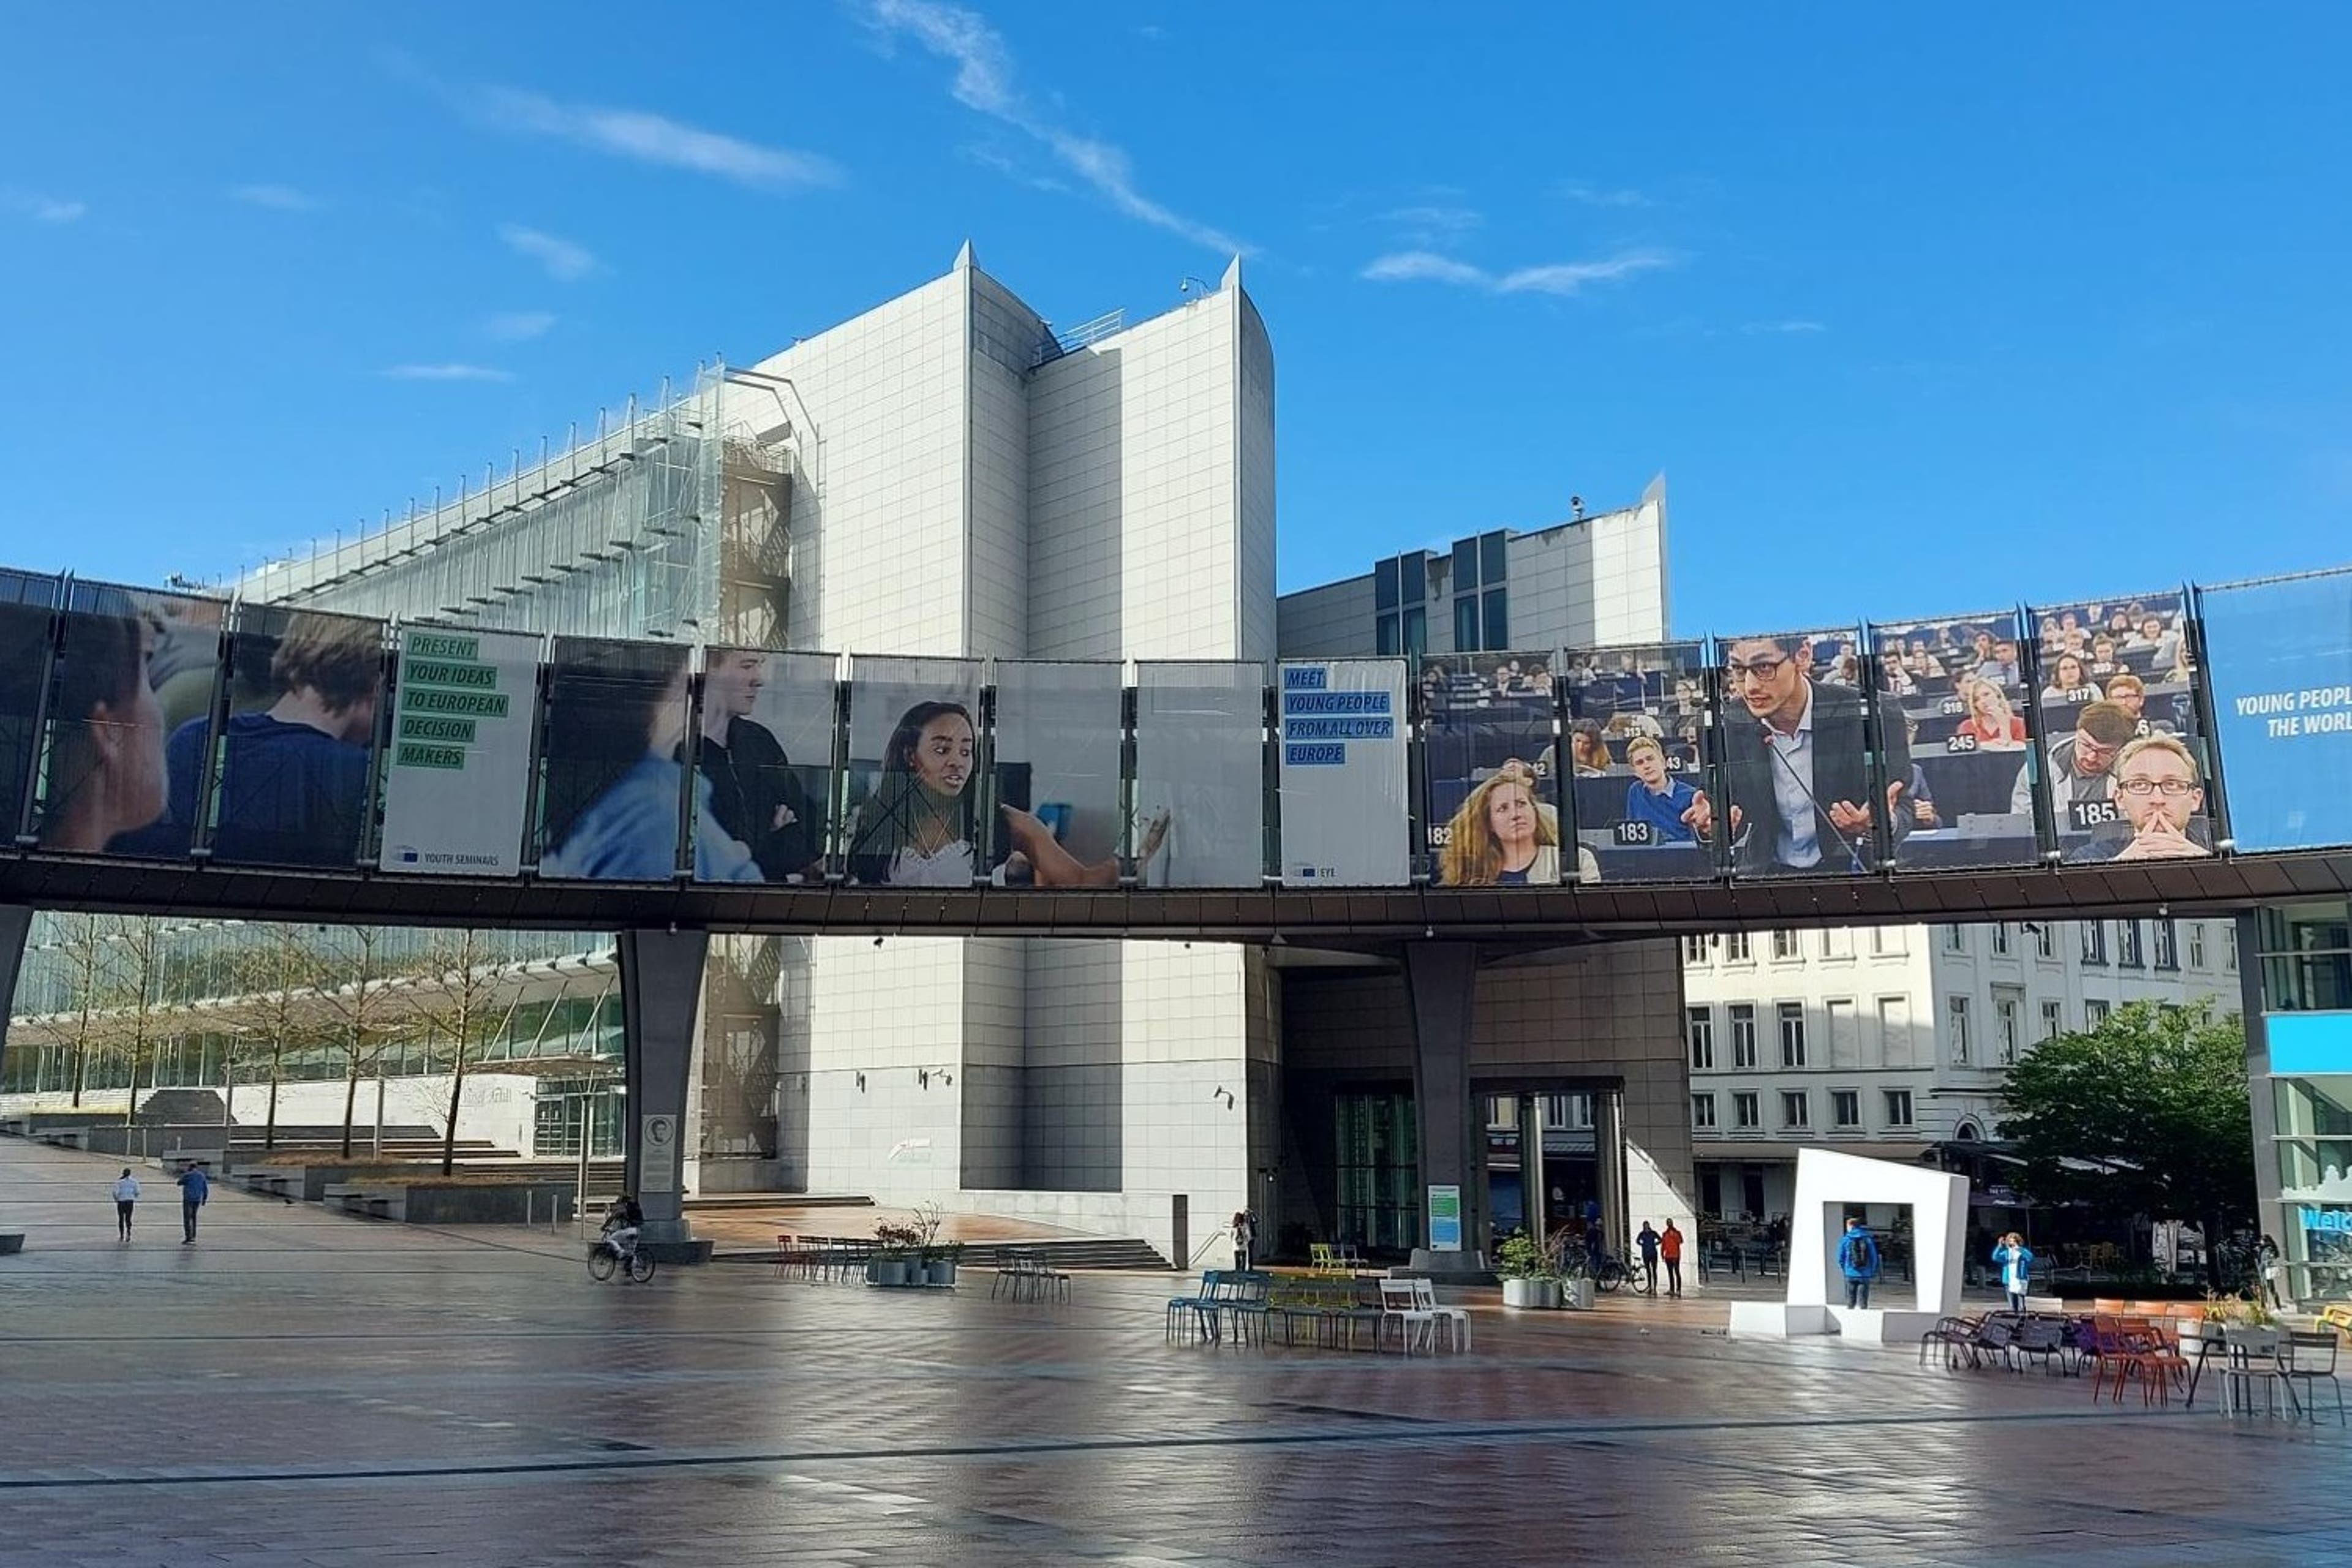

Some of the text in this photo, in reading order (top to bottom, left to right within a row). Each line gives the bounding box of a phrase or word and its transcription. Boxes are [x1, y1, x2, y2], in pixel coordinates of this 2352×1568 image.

[411, 636, 476, 656] PRESENT
[410, 664, 495, 685] YOUR IDEAS
[1288, 672, 1325, 685] MEET
[407, 692, 506, 714] TO EUROPEAN
[1289, 696, 1388, 710] YOUNG PEOPLE
[2068, 689, 2089, 701] 317
[2236, 693, 2295, 716] YOUNG
[404, 720, 472, 737] DECISION
[1289, 721, 1391, 736] FROM ALL OVER
[2267, 711, 2352, 737] THE WORL
[1948, 736, 1974, 750] 245
[400, 748, 461, 765] MAKERS
[1290, 747, 1342, 761] EUROPE
[2075, 803, 2116, 825] 185
[1428, 827, 1452, 845] 182
[1618, 823, 1649, 842] 183
[424, 853, 453, 865] YOUTH
